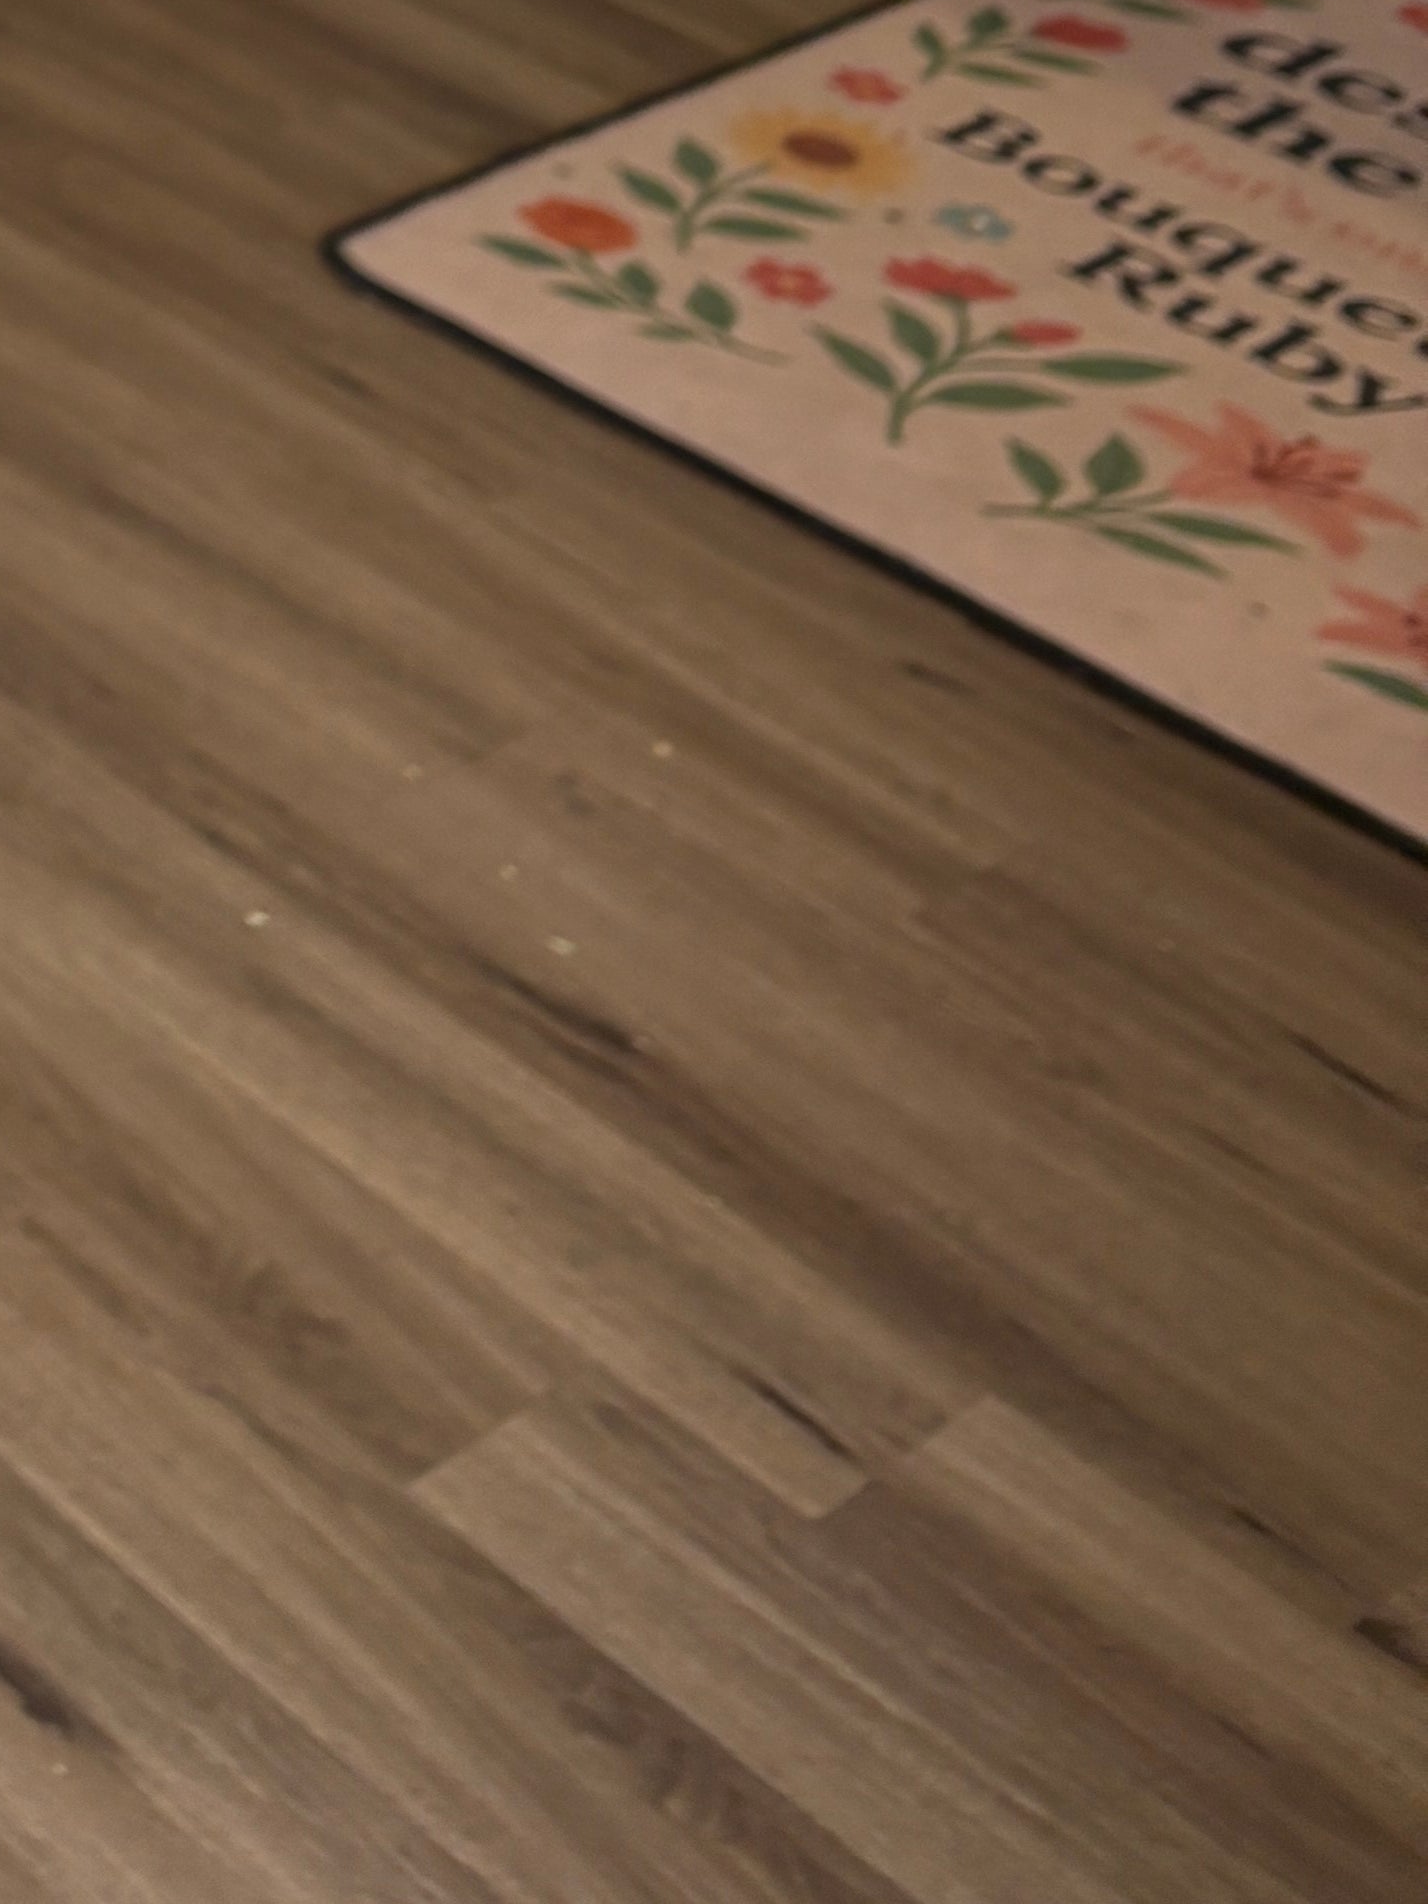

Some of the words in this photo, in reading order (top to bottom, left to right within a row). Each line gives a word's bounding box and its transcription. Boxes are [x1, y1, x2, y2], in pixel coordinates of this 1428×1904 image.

[1172, 80, 1420, 197] the
[934, 106, 1428, 364] Bouque
[1058, 239, 1428, 418] Ruby
